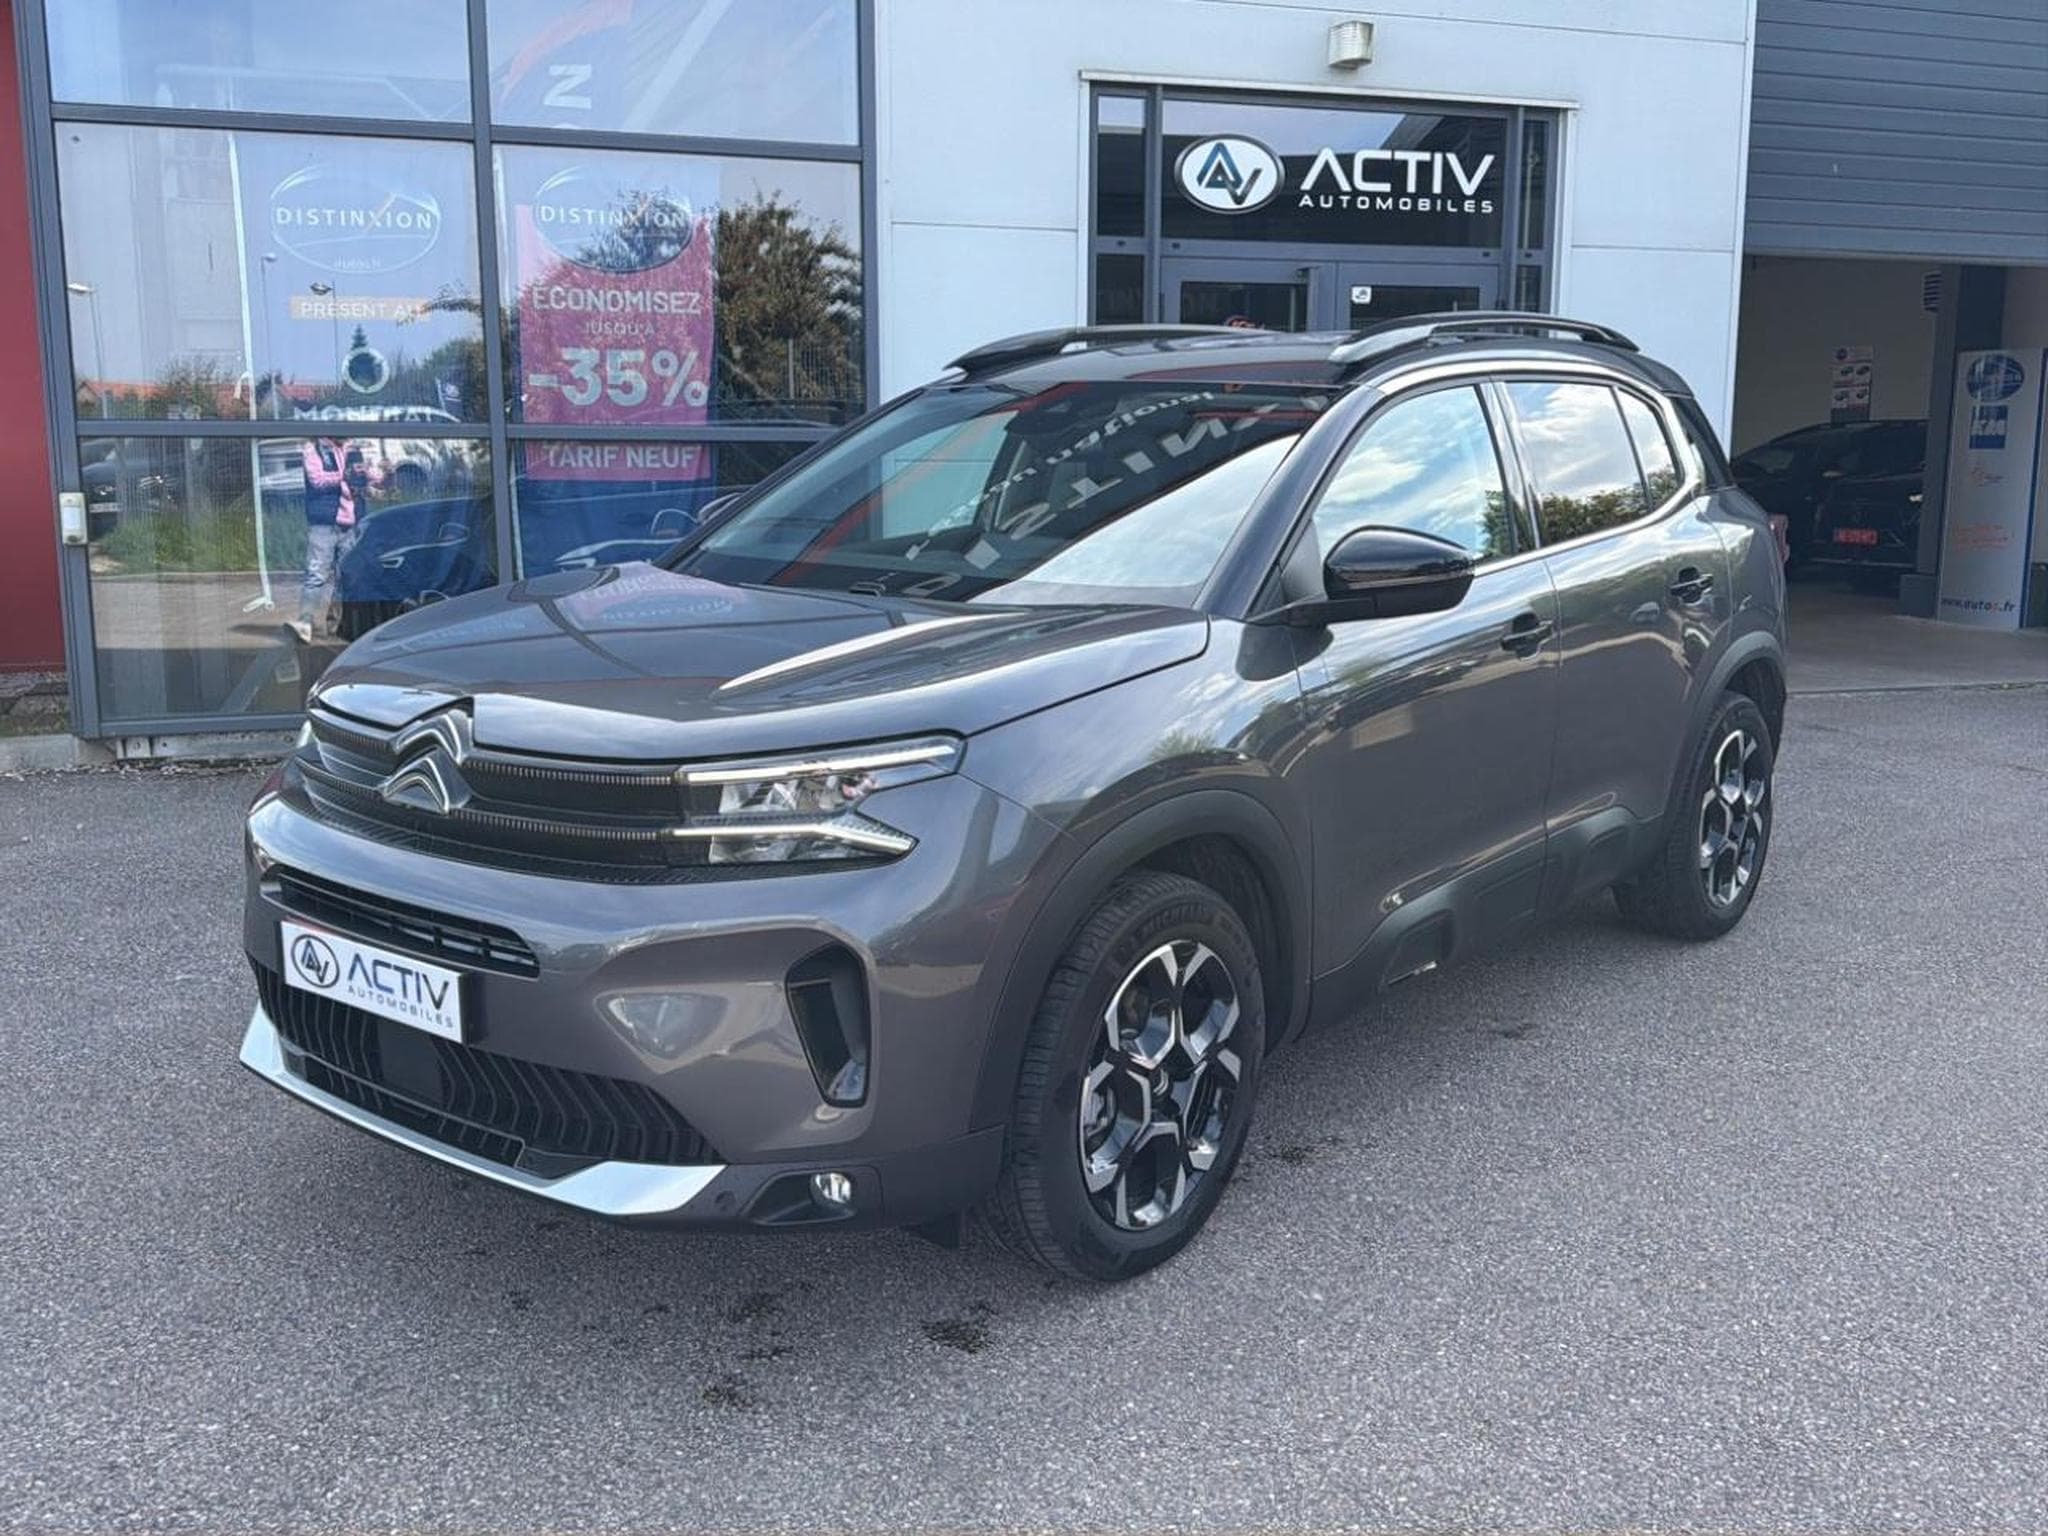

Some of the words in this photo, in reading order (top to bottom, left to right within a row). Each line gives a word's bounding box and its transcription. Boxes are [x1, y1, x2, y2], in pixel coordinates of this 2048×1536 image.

[1300, 147, 1495, 196] ACTIV
[276, 205, 433, 231] DISTINXION
[540, 204, 686, 229] DISTINXION
[1298, 195, 1494, 214] AUTOMOBILES
[528, 346, 709, 407] -35%
[543, 444, 621, 469] TARIF
[626, 446, 696, 469] NEUF
[348, 952, 450, 1011] ACTIV
[347, 984, 454, 1028] AUTOMOBILES
